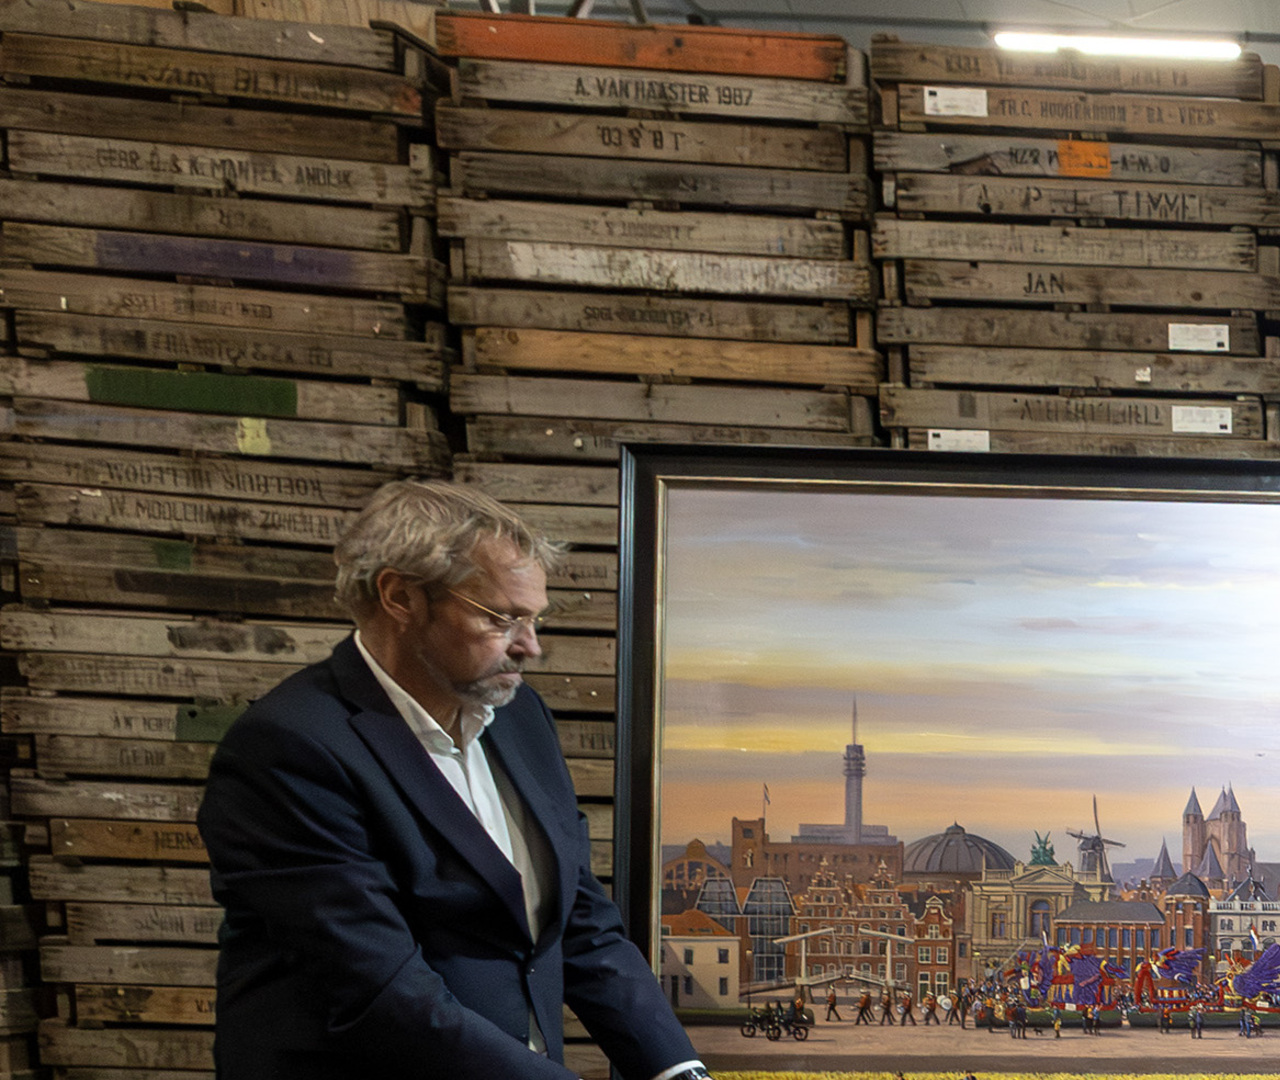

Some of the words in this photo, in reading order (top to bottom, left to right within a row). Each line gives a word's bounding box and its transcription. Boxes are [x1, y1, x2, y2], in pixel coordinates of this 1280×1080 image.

[574, 77, 591, 97] A.
[595, 77, 631, 99] VAN
[633, 80, 711, 106] HAASTER
[715, 85, 754, 107] 1987
[1023, 273, 1066, 294] JAN
